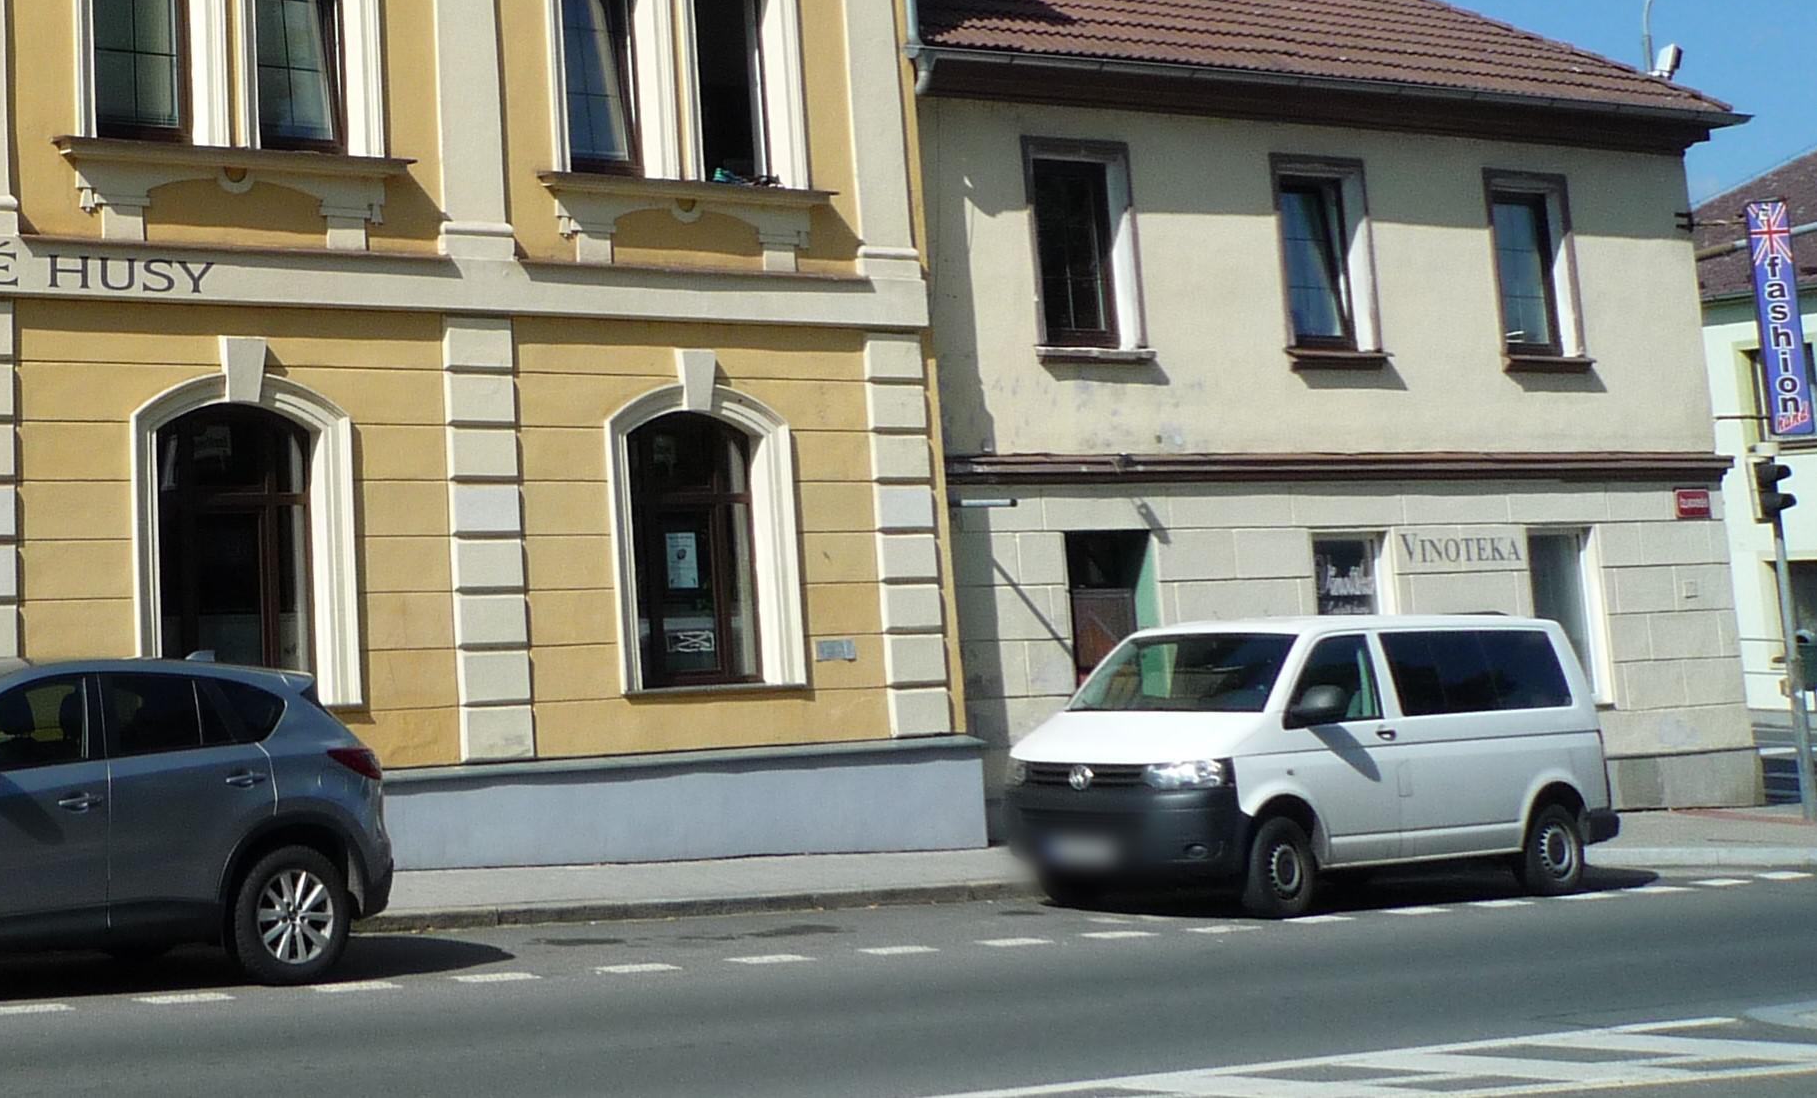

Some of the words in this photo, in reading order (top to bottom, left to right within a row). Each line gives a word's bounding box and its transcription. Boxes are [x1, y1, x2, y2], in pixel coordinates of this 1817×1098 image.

[48, 254, 215, 294] HUSY
[1766, 255, 1801, 415] fashion
[1400, 533, 1522, 564] VINOTEKA
